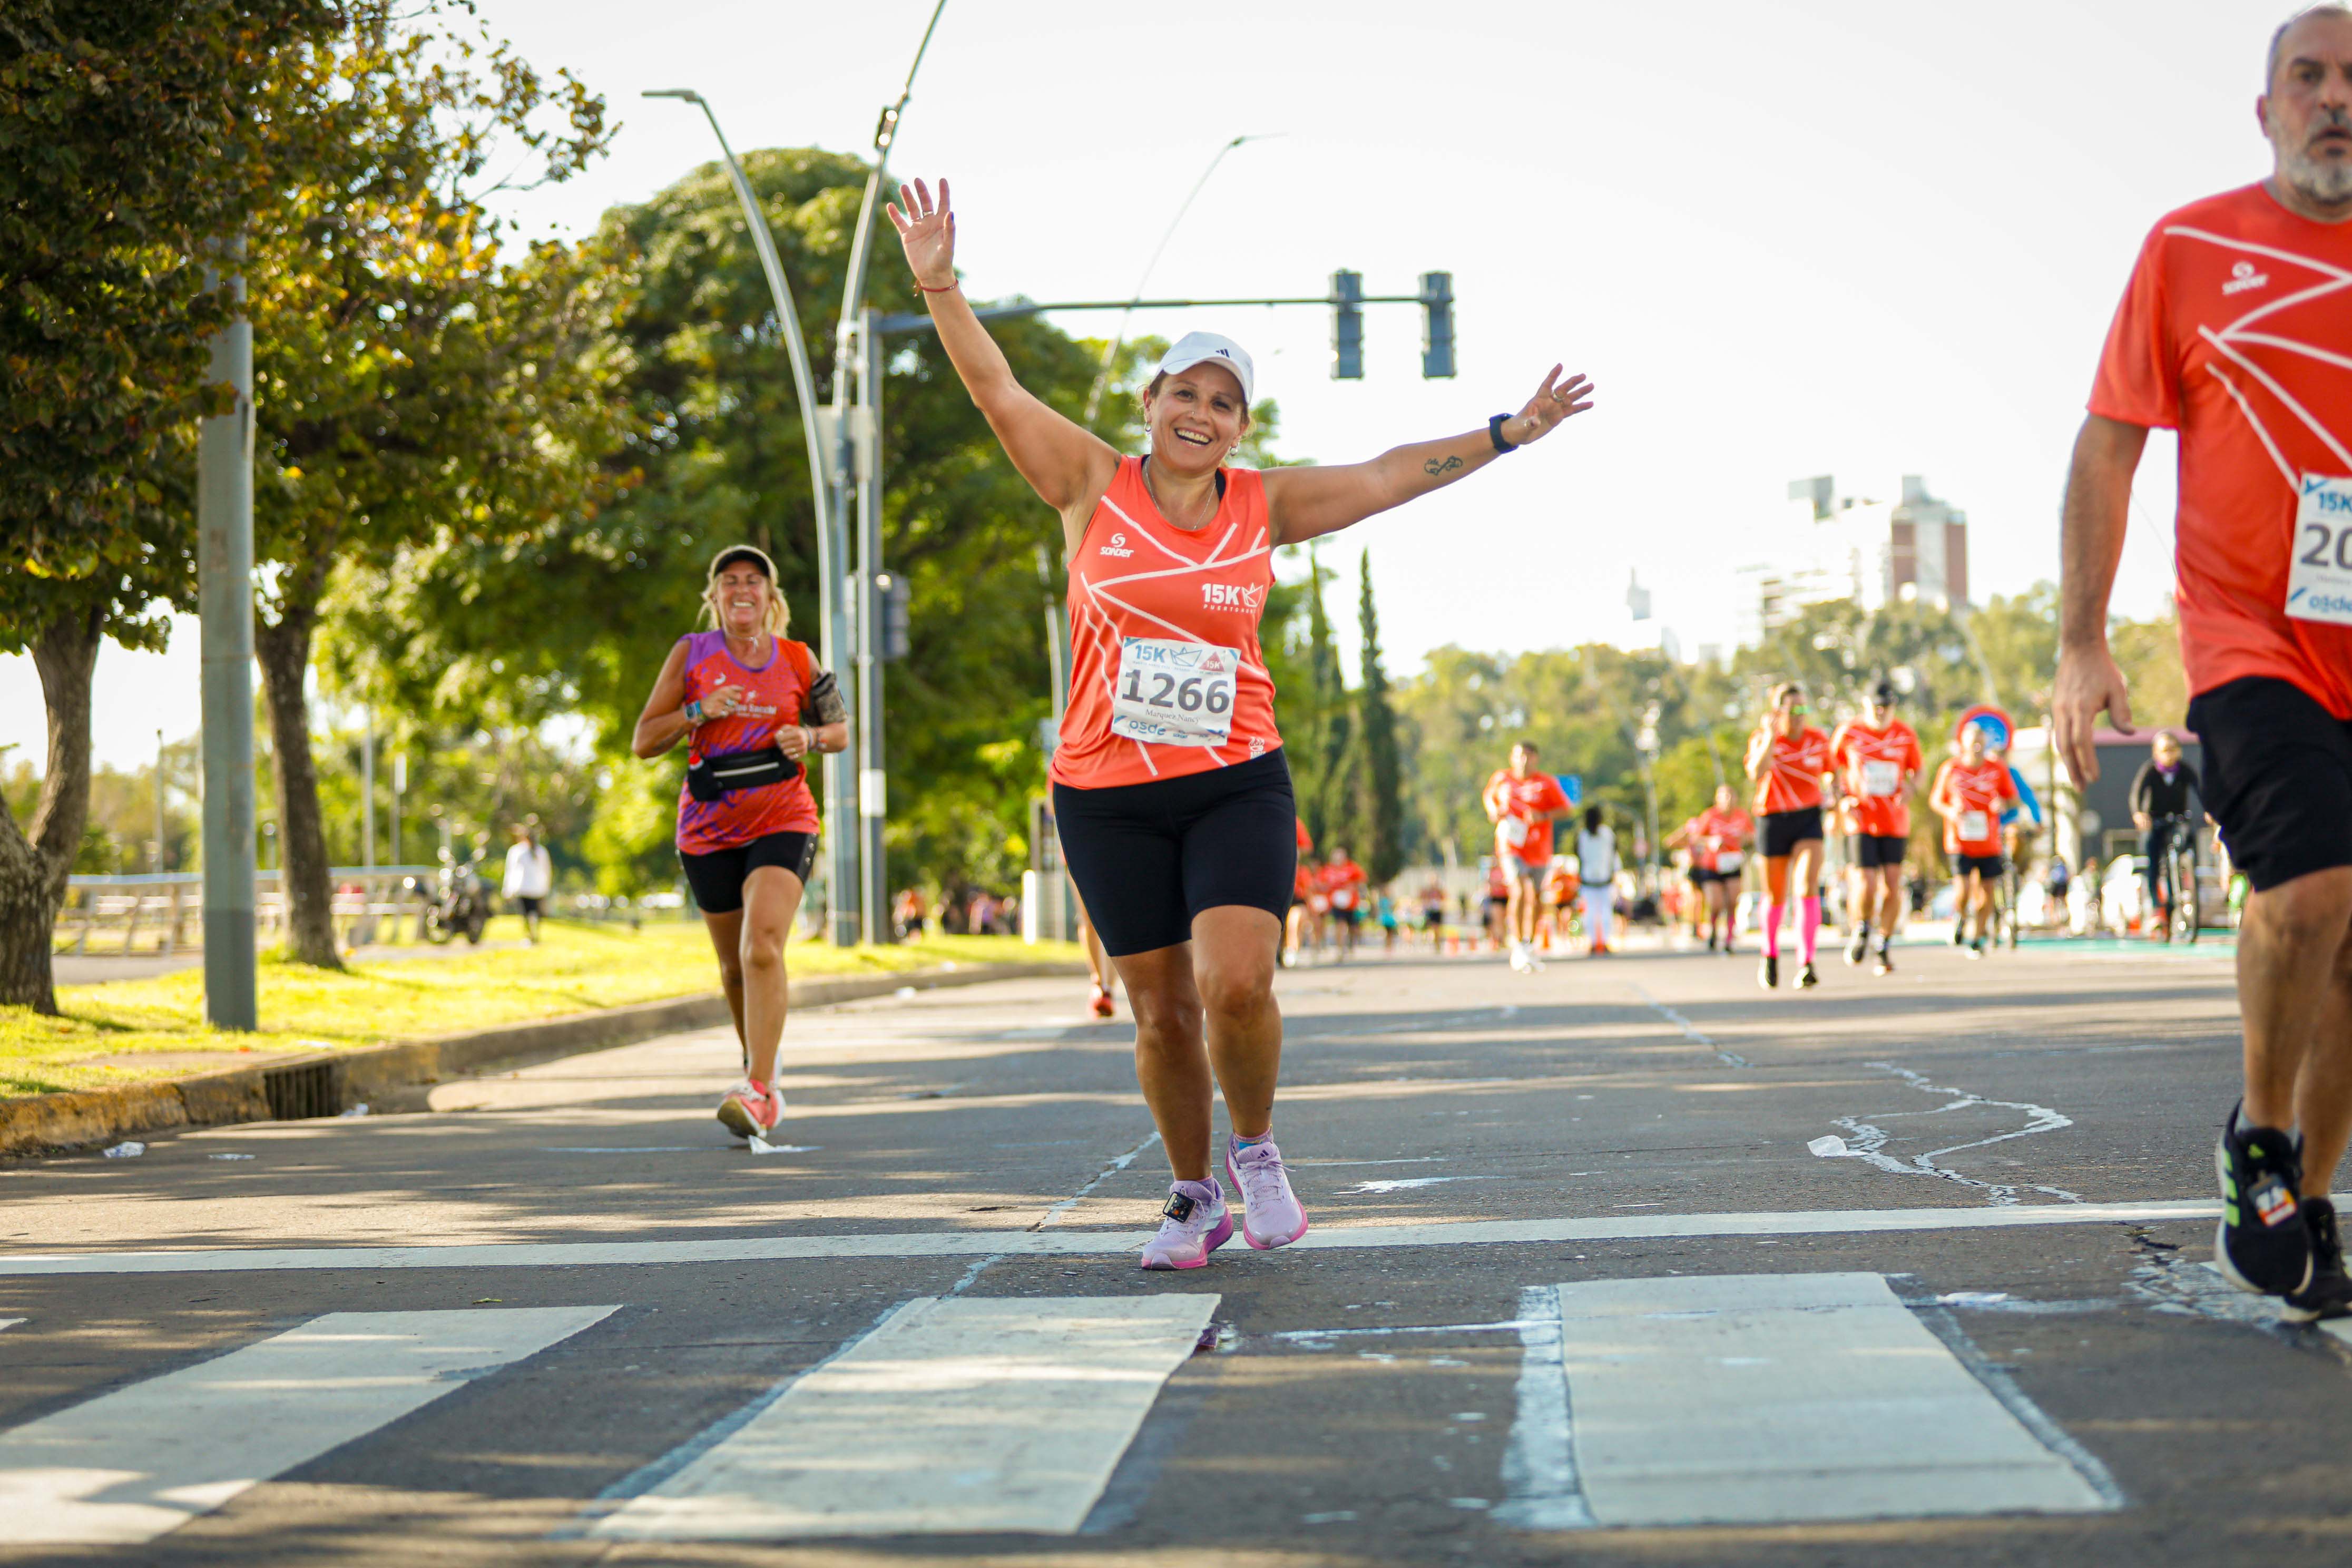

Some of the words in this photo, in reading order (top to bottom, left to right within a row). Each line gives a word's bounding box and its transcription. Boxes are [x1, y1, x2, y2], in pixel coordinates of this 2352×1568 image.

[2300, 524, 2352, 570] 20
[1202, 583, 1241, 605] 15K
[1135, 644, 1167, 663] 15K
[1206, 660, 1221, 669] 15K
[1122, 669, 1230, 713] 1266
